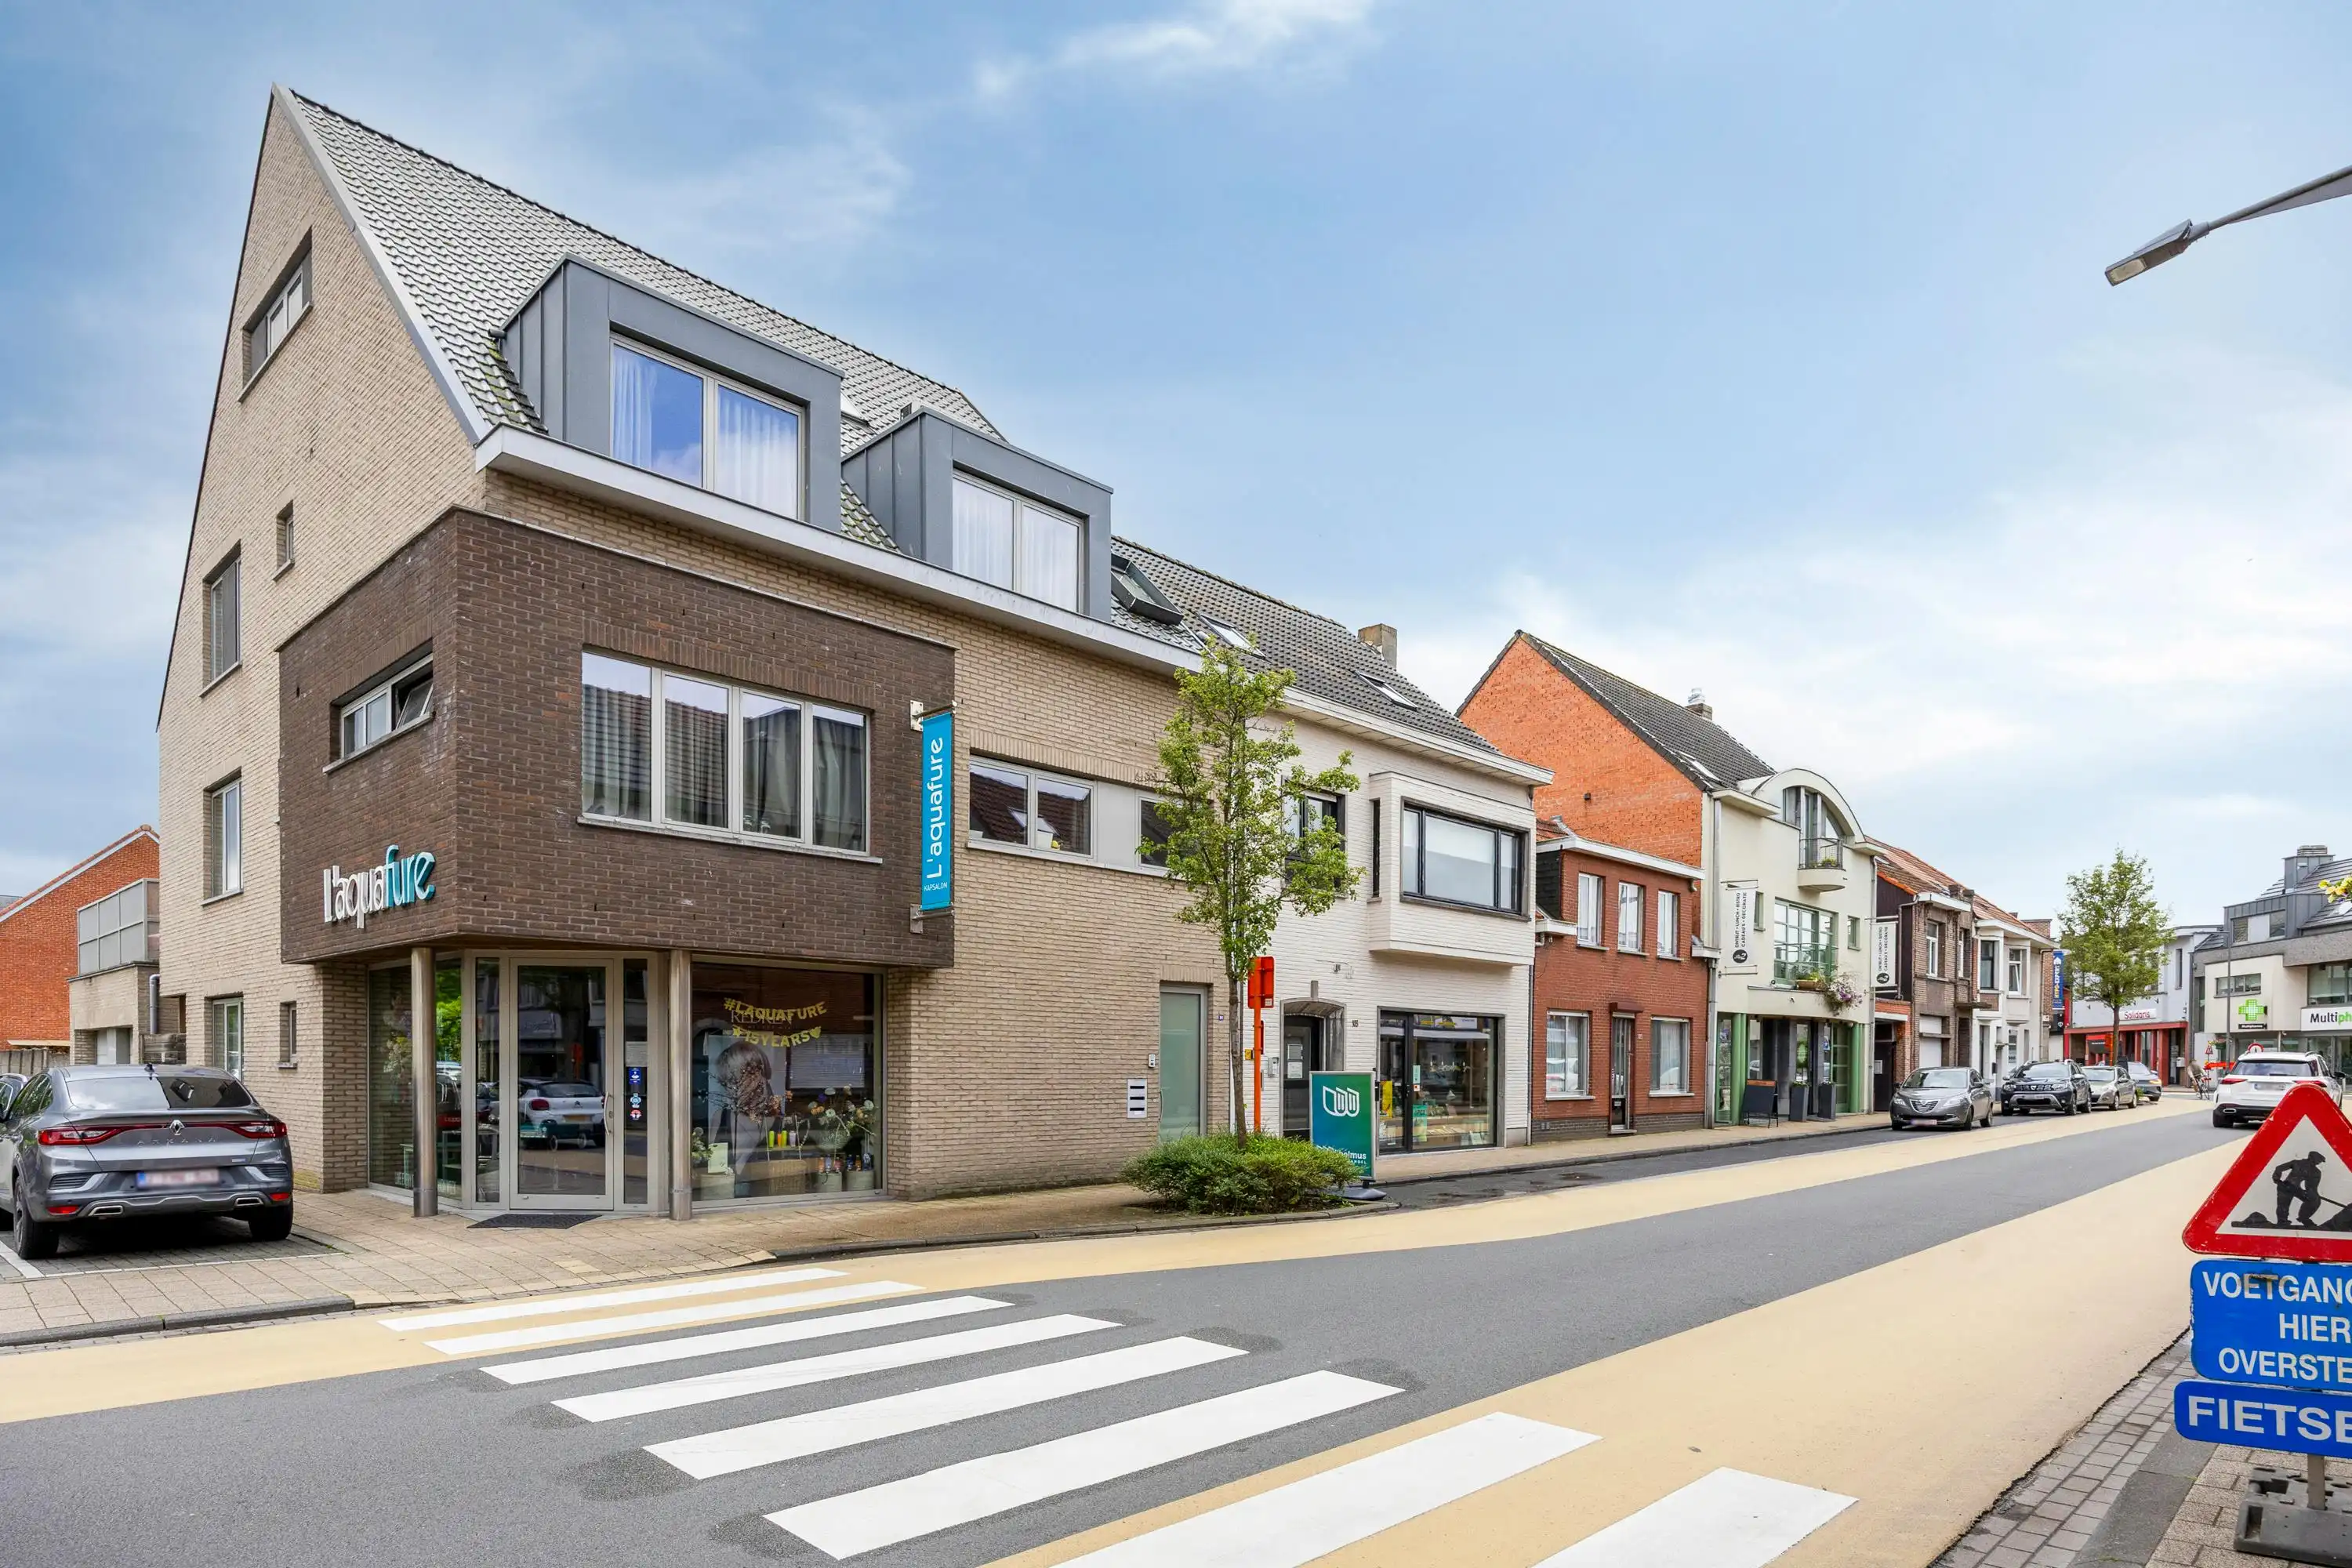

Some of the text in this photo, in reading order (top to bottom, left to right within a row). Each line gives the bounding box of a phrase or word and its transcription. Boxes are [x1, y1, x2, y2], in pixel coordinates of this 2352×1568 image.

[927, 737, 946, 879] L'aquafure
[924, 881, 948, 891] KAPSALON
[724, 997, 827, 1022] #LAQUAFURE
[2279, 1313, 2351, 1344] HIER
[2218, 1347, 2352, 1384] OVERSTE
